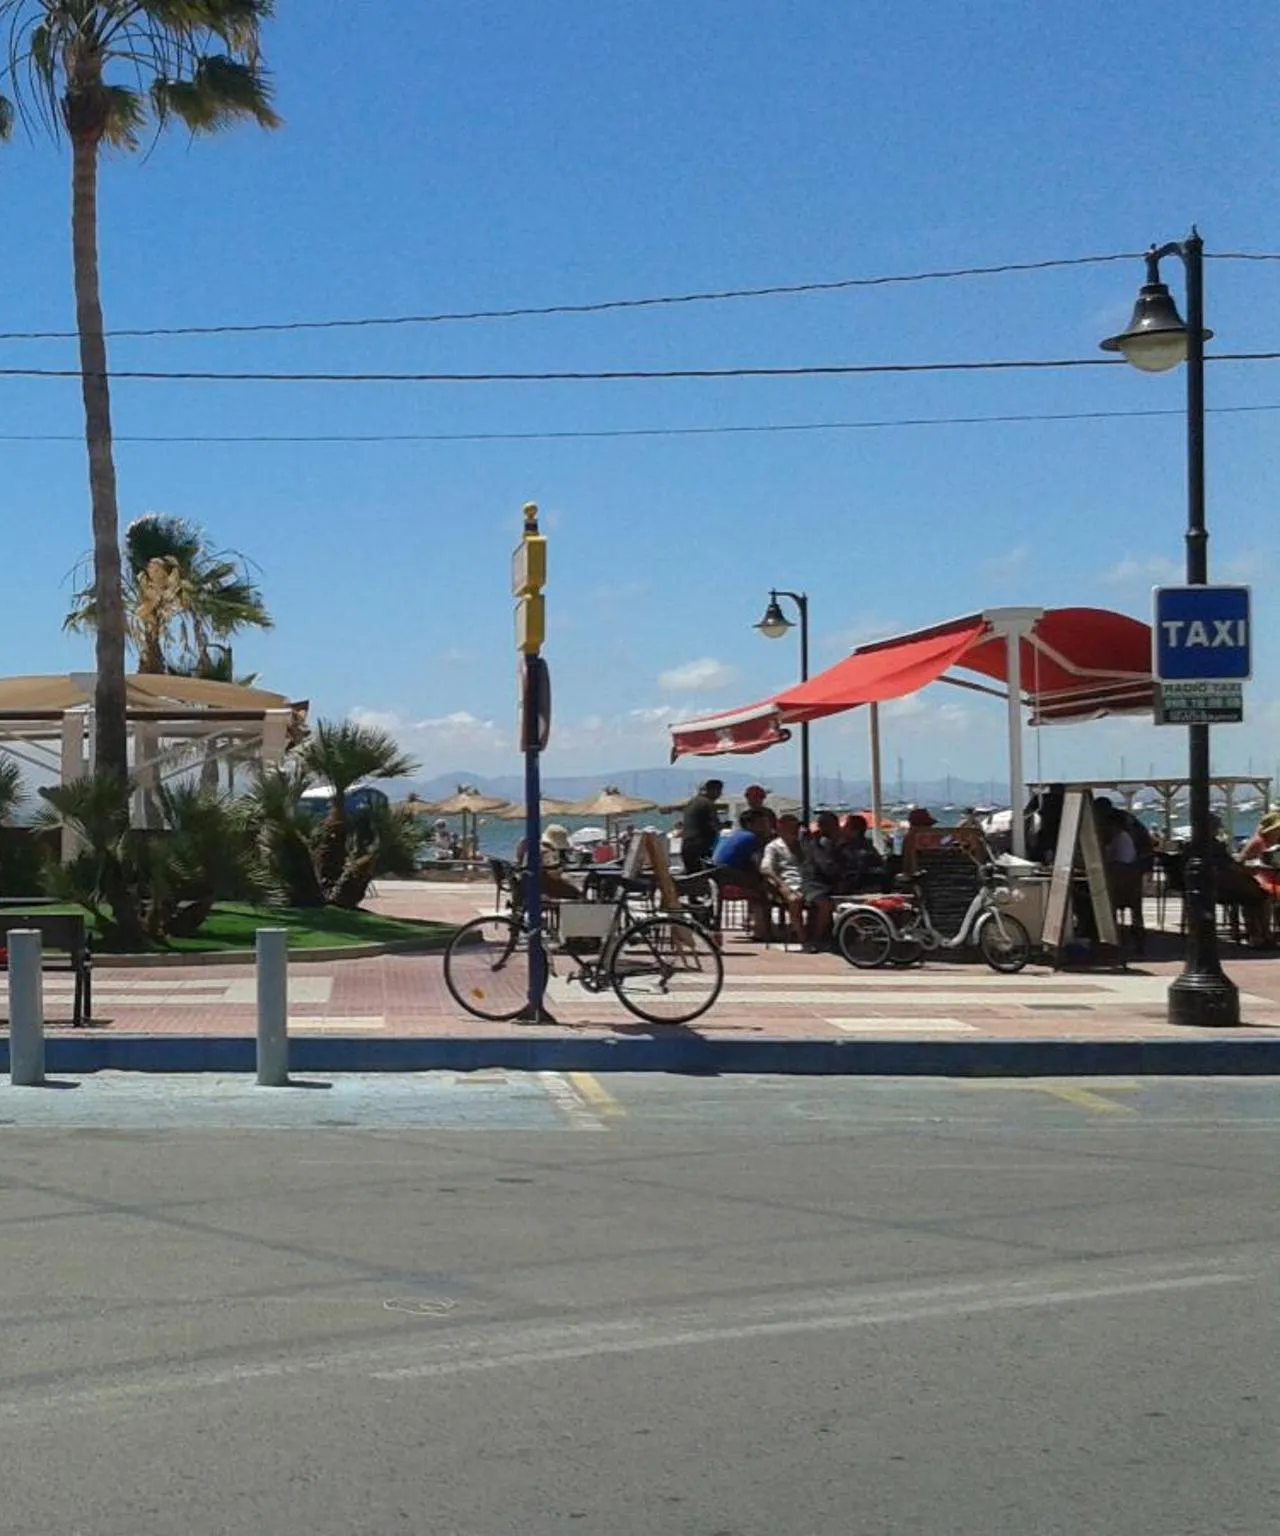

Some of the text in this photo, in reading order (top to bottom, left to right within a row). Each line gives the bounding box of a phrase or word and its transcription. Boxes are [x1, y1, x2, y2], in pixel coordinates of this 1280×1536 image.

[1162, 620, 1246, 648] TAXI
[1163, 682, 1242, 693] RADIO TAXI
